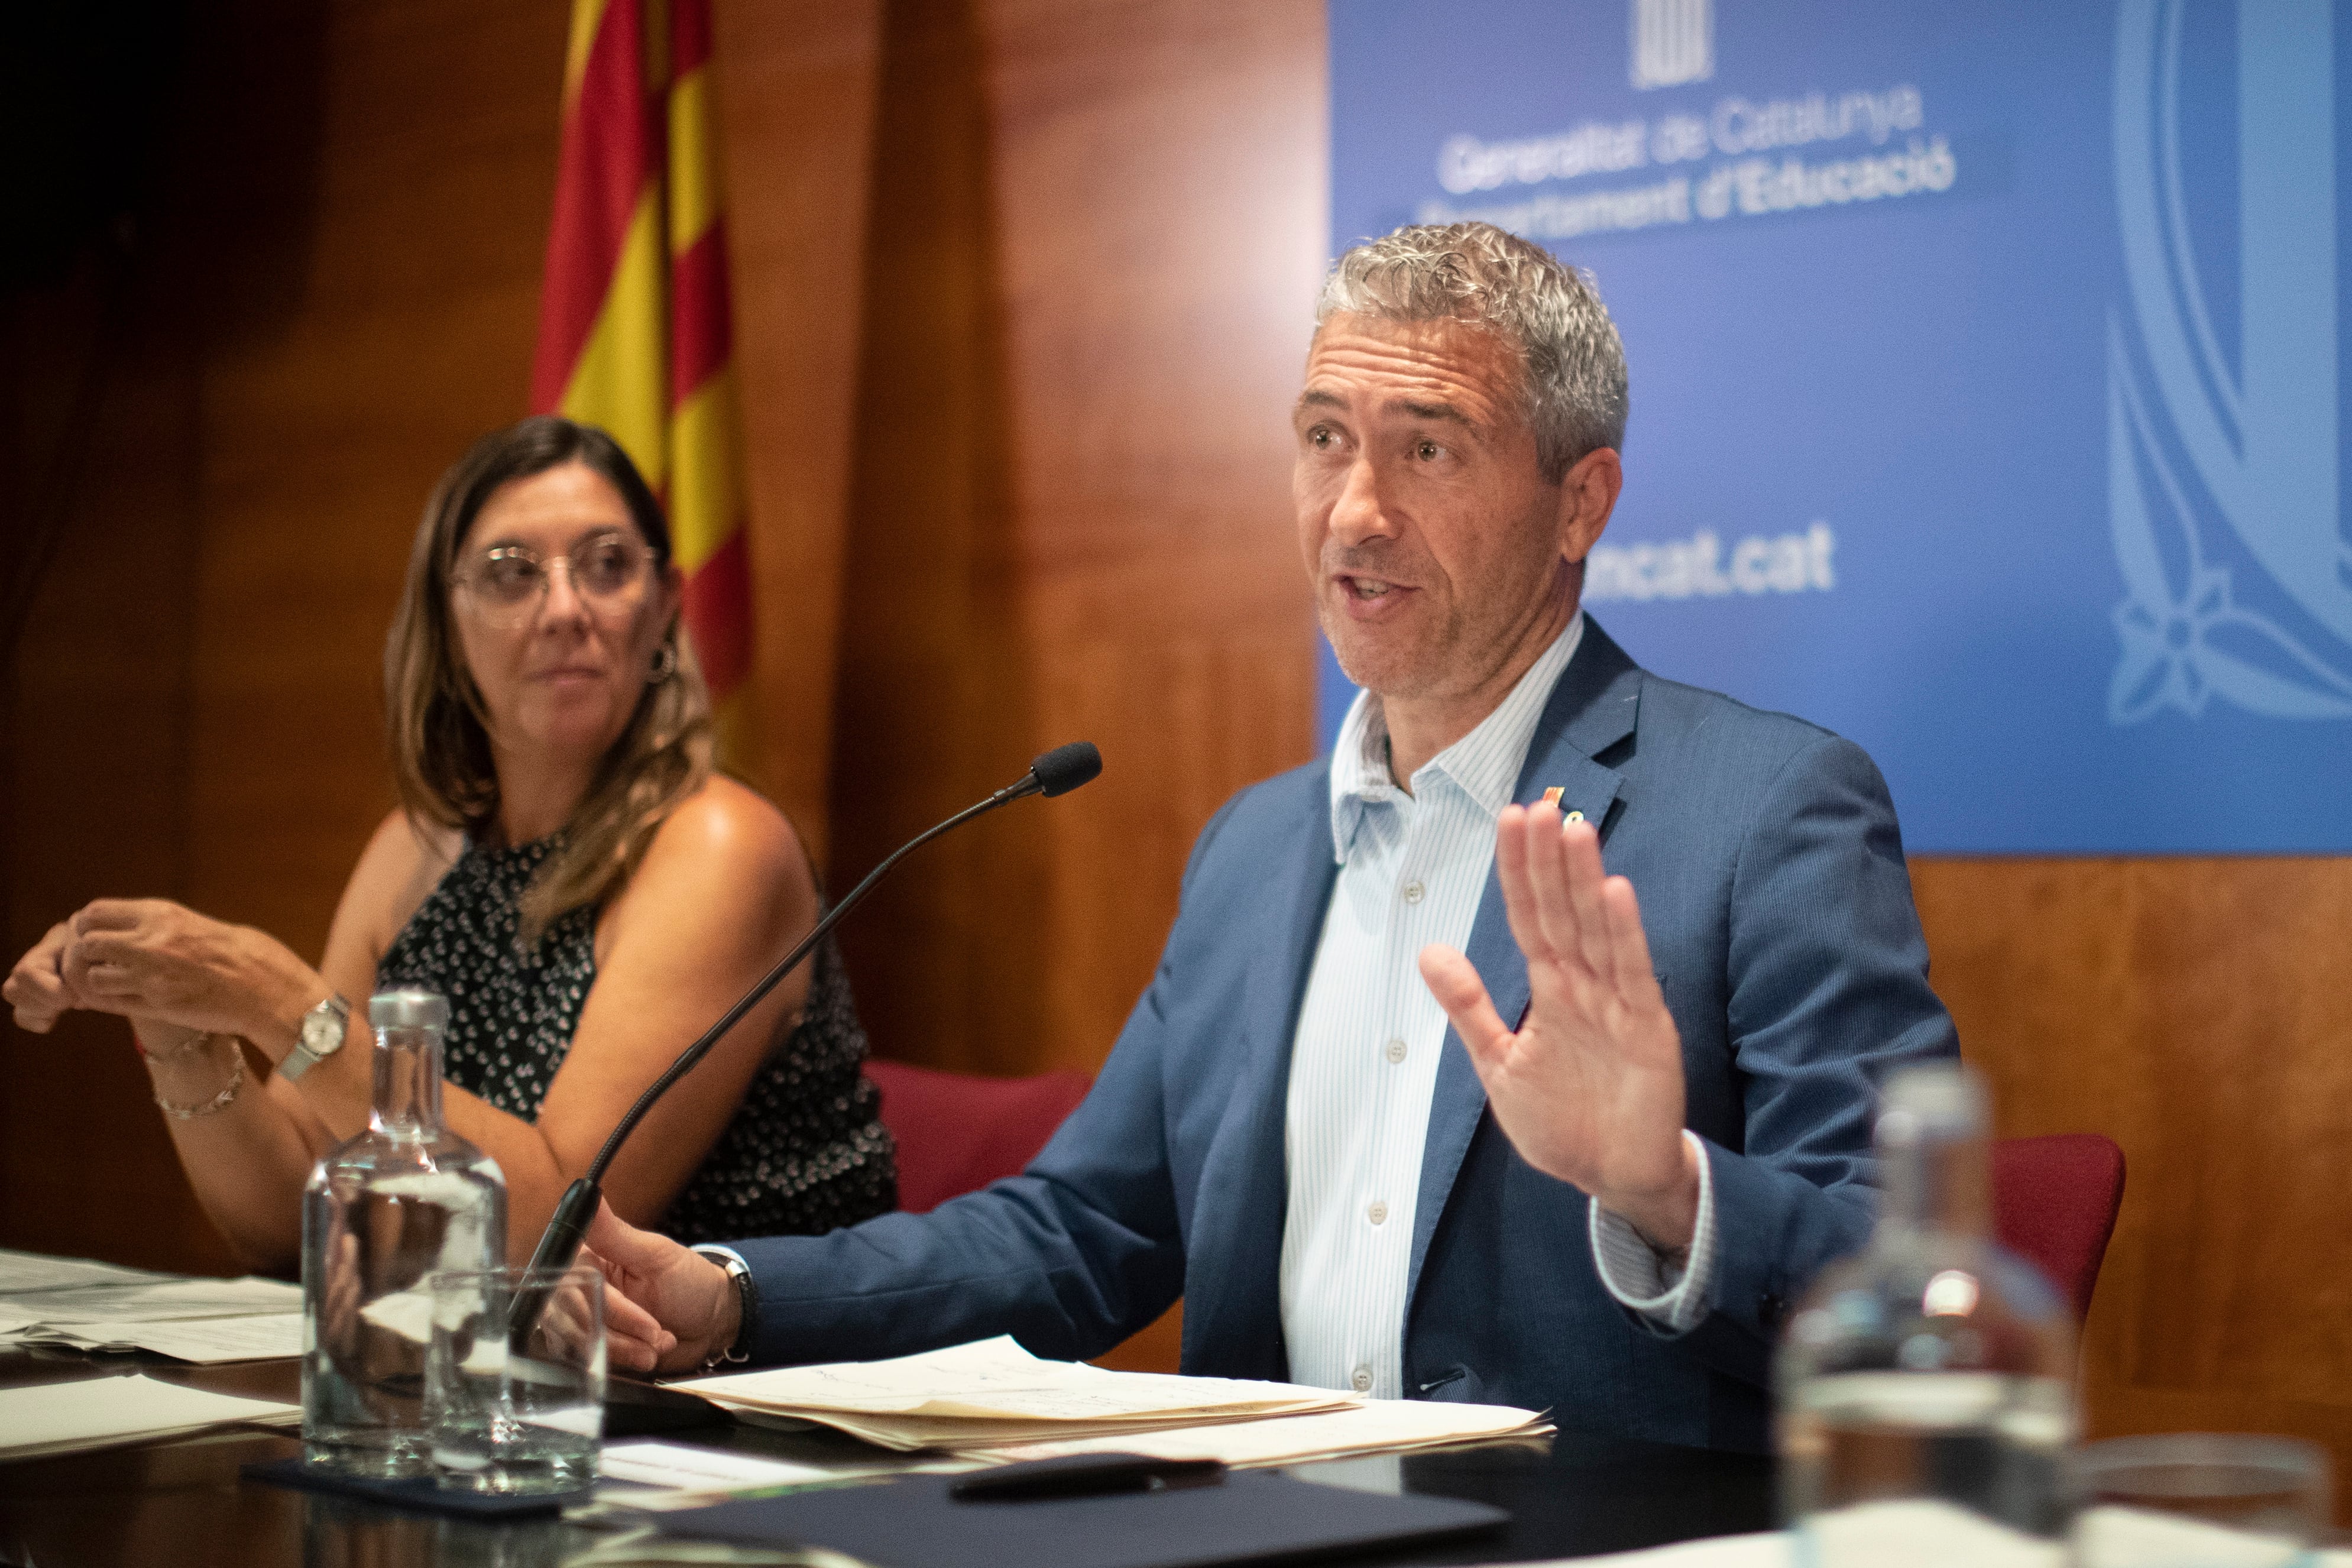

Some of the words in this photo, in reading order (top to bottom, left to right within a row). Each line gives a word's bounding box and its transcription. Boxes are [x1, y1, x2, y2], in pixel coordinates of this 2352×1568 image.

[1439, 121, 1647, 193] Generalitat
[1654, 116, 1708, 164] de
[1714, 85, 1922, 154] Catalunya
[1697, 134, 1954, 219] d'Educació
[1582, 523, 1832, 600] ncat.cat
